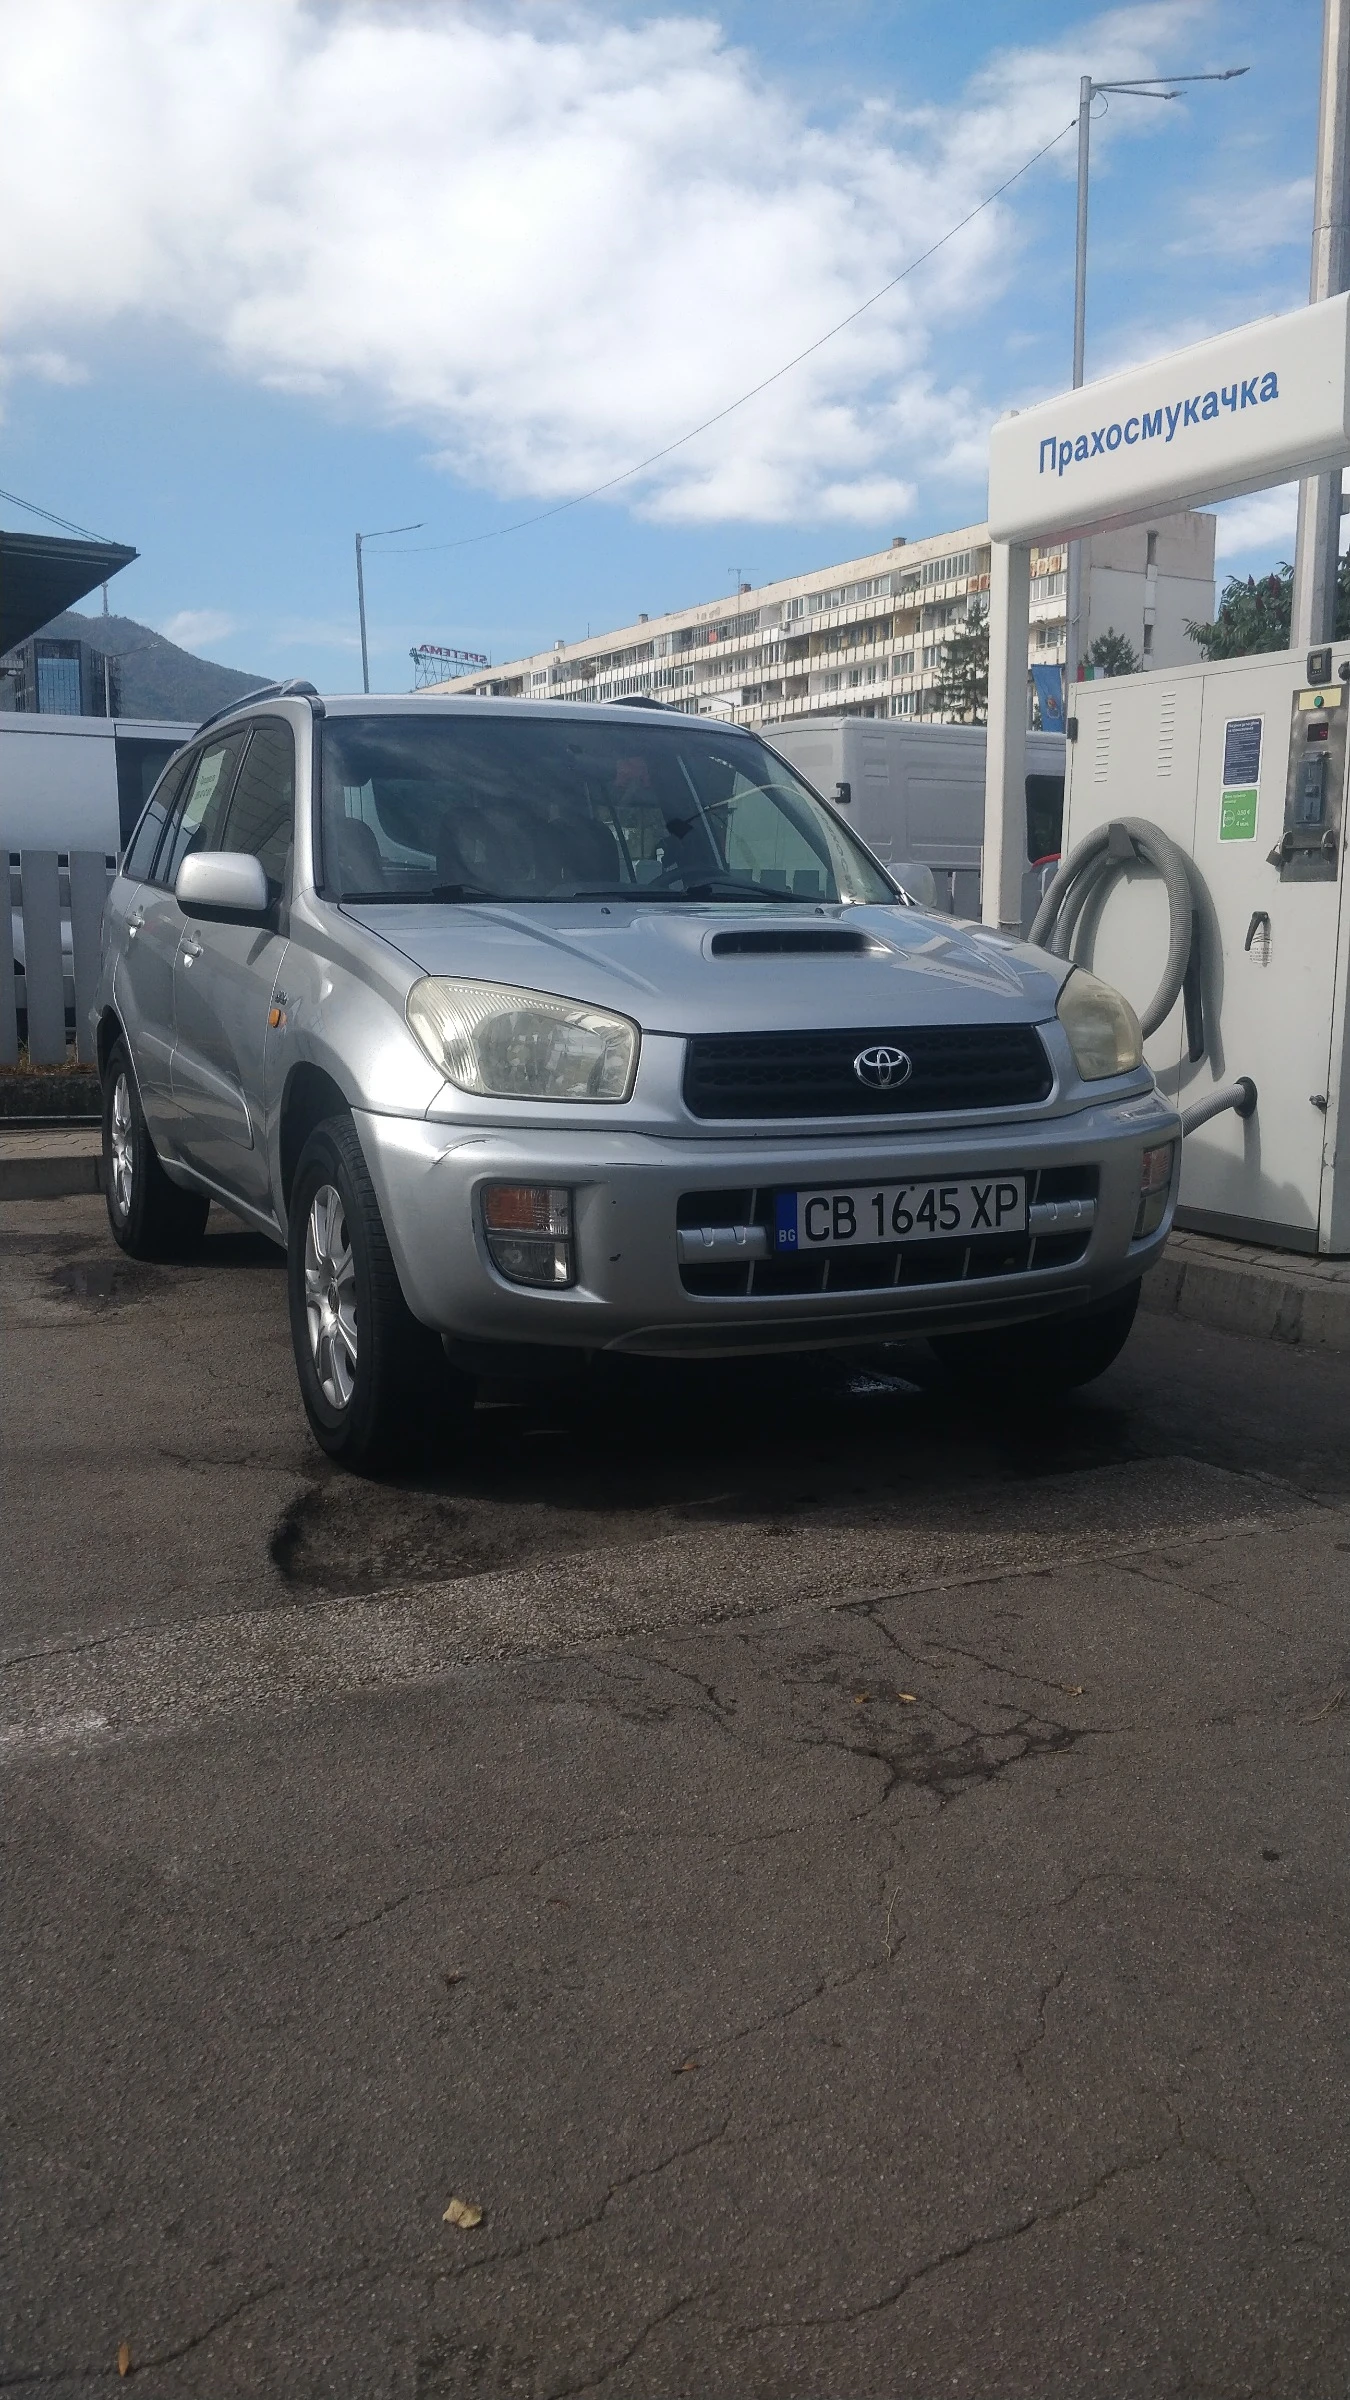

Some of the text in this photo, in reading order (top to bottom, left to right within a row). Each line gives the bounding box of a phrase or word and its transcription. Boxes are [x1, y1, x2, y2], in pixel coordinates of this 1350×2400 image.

[1038, 371, 1279, 476] Прахосмукачка
[778, 1229, 796, 1243] BG
[804, 1183, 1019, 1241] CB 1645 XP
